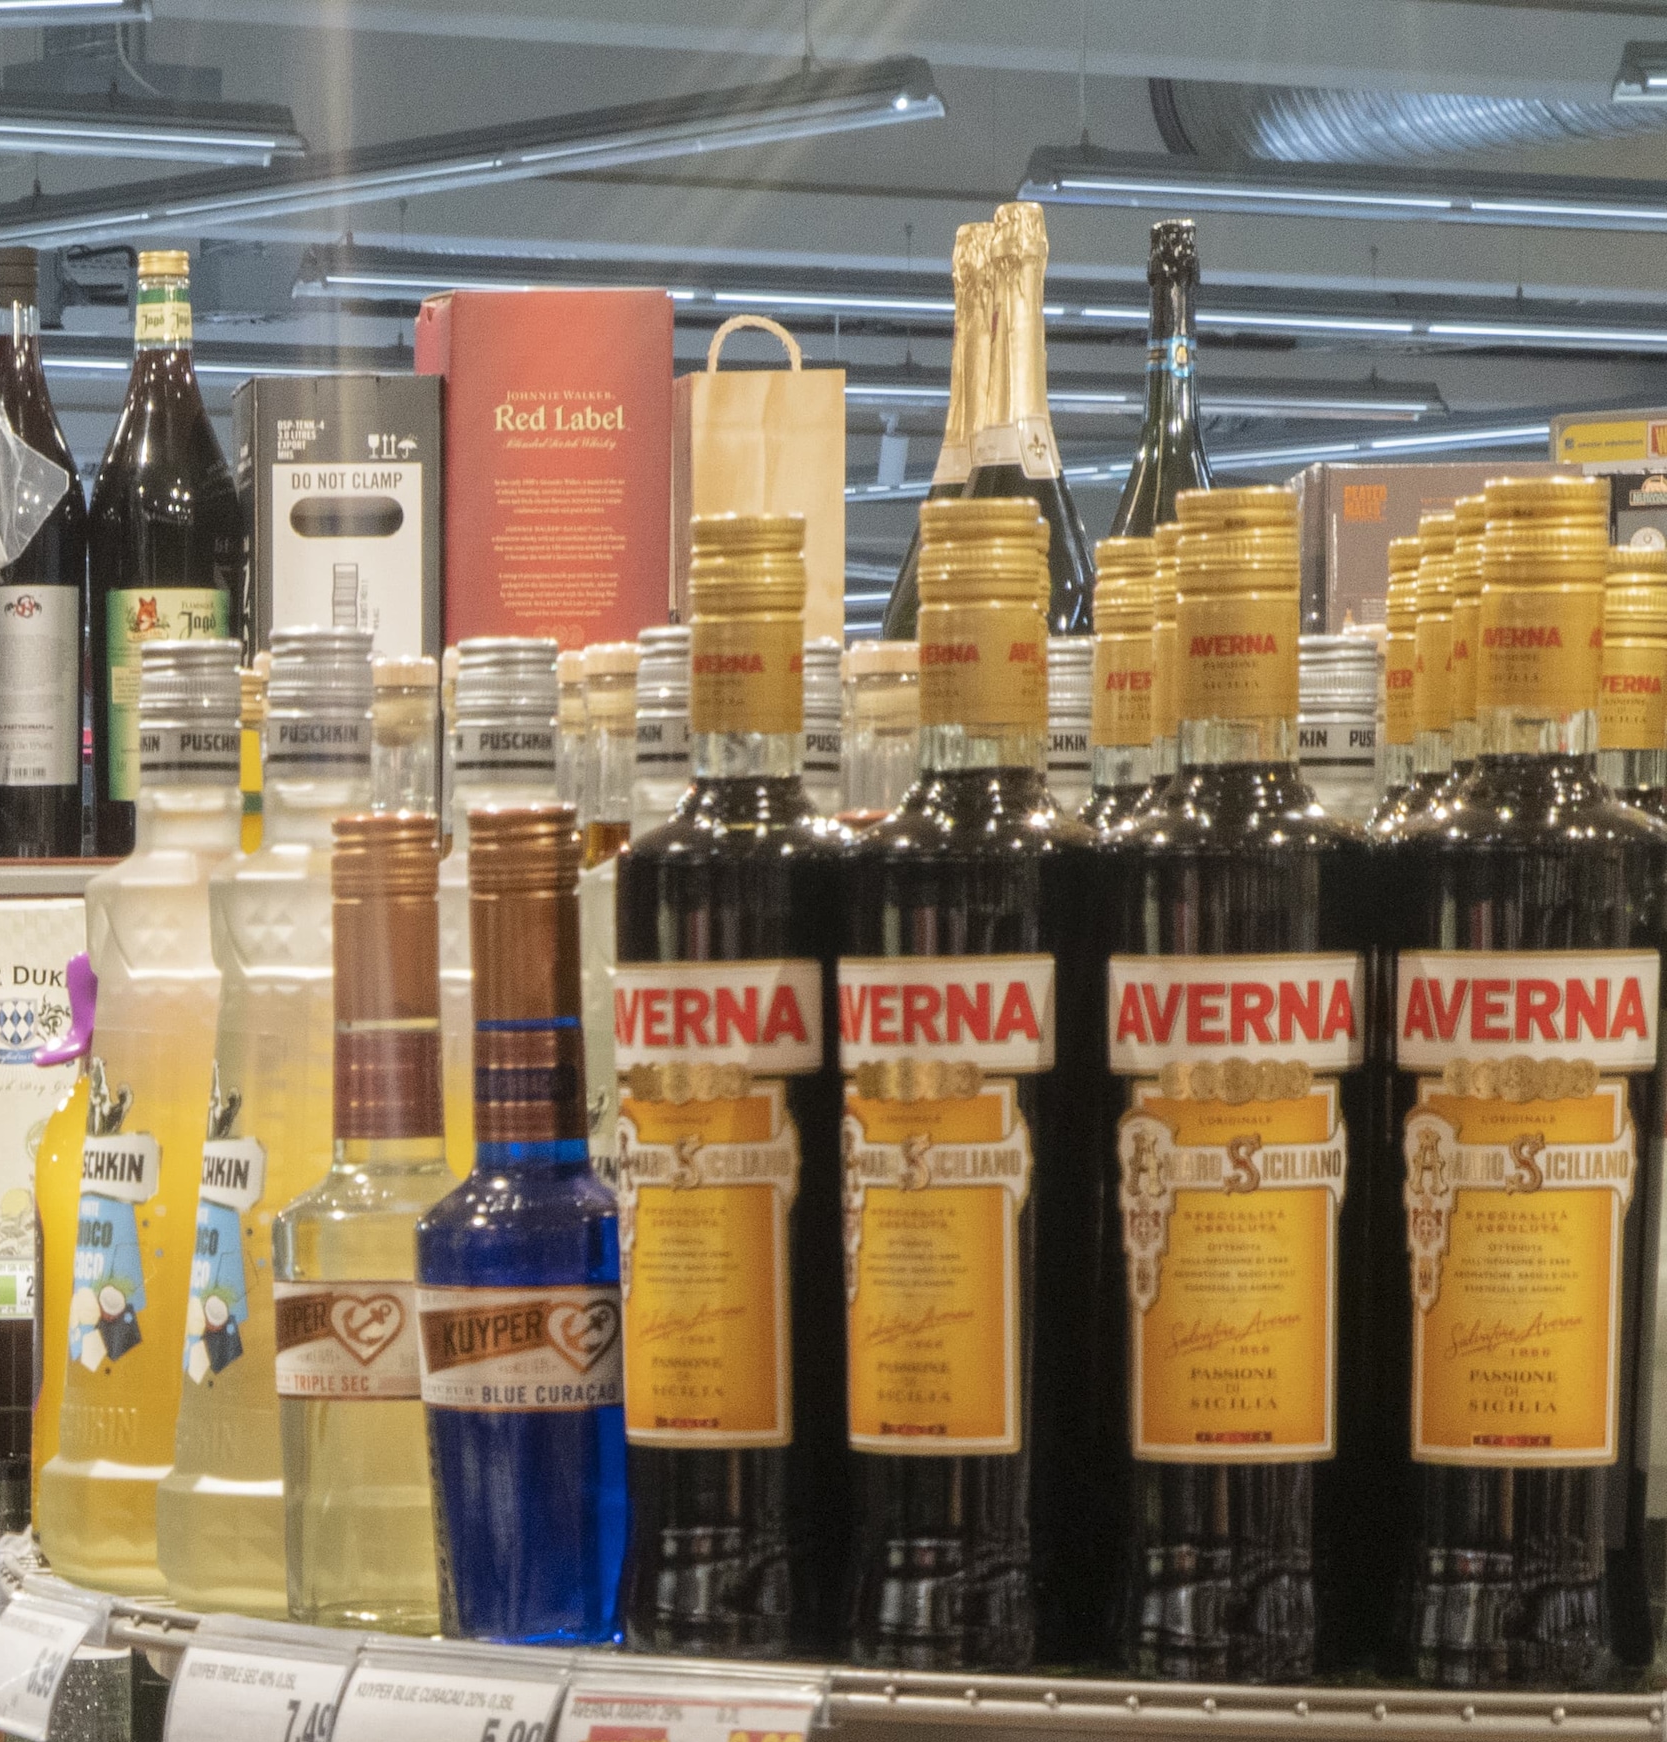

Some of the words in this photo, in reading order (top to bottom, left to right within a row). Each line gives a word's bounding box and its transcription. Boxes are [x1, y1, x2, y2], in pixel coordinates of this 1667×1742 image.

[506, 390, 559, 401] JOHNNIE
[563, 390, 612, 399] WALKER
[494, 405, 546, 431] Red
[554, 404, 625, 431] Label
[277, 440, 306, 450] EXPORT
[291, 473, 312, 489] DO
[318, 473, 346, 489] NOT
[352, 473, 402, 489] CLAMP
[1189, 634, 1277, 658] AVERNA
[279, 724, 361, 745] PUSCHKIN
[12, 965, 69, 985] DUK
[1116, 978, 1357, 1045] AVERNA
[1404, 977, 1649, 1041] AVERNA
[443, 1310, 544, 1356] KUYPER
[294, 1374, 336, 1391] TRIPLE
[341, 1374, 370, 1391] SEC
[1469, 1369, 1557, 1384] PASSIONE
[481, 1384, 527, 1403] BLUE
